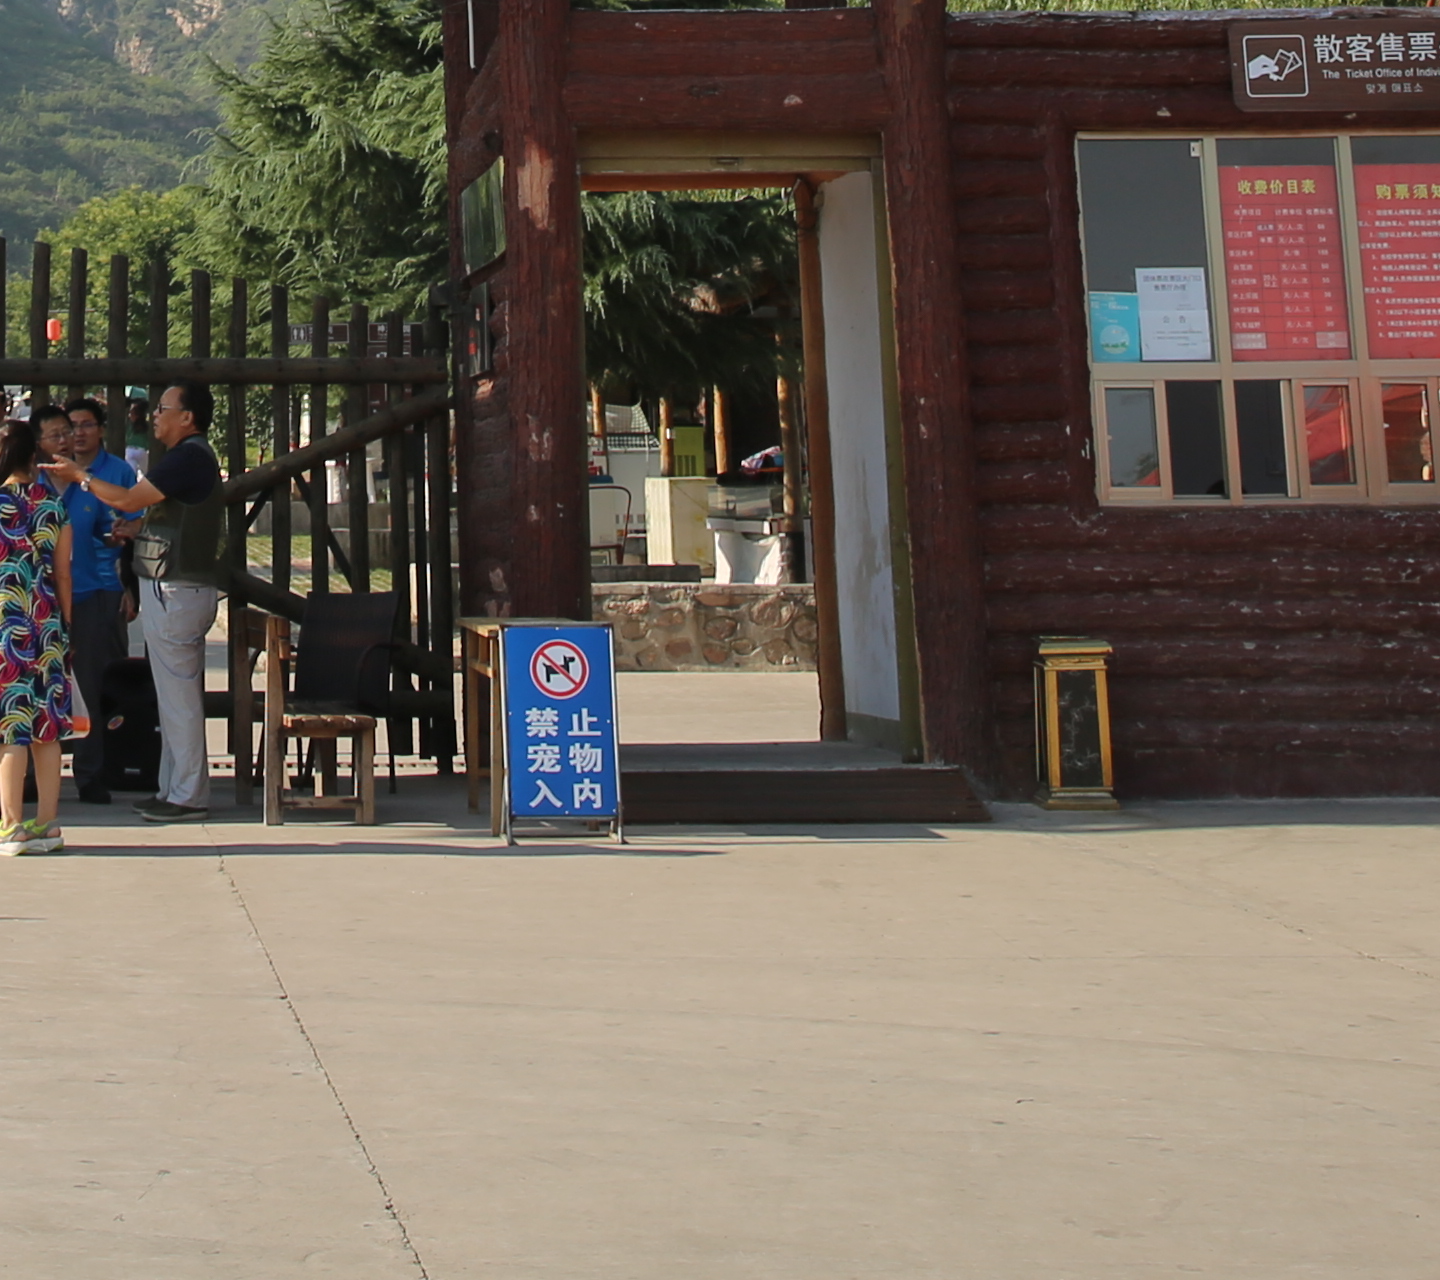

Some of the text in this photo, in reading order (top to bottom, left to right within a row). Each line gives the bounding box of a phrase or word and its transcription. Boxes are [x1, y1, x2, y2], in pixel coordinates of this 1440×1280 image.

[1322, 69, 1340, 79] The
[1346, 68, 1373, 79] Ticket
[1375, 67, 1402, 78] Office
[1405, 67, 1414, 77] of
[1237, 179, 1316, 195] 收费价目表
[525, 707, 602, 738] 禁止
[527, 743, 603, 774] 宠物
[529, 778, 603, 809] 入内
